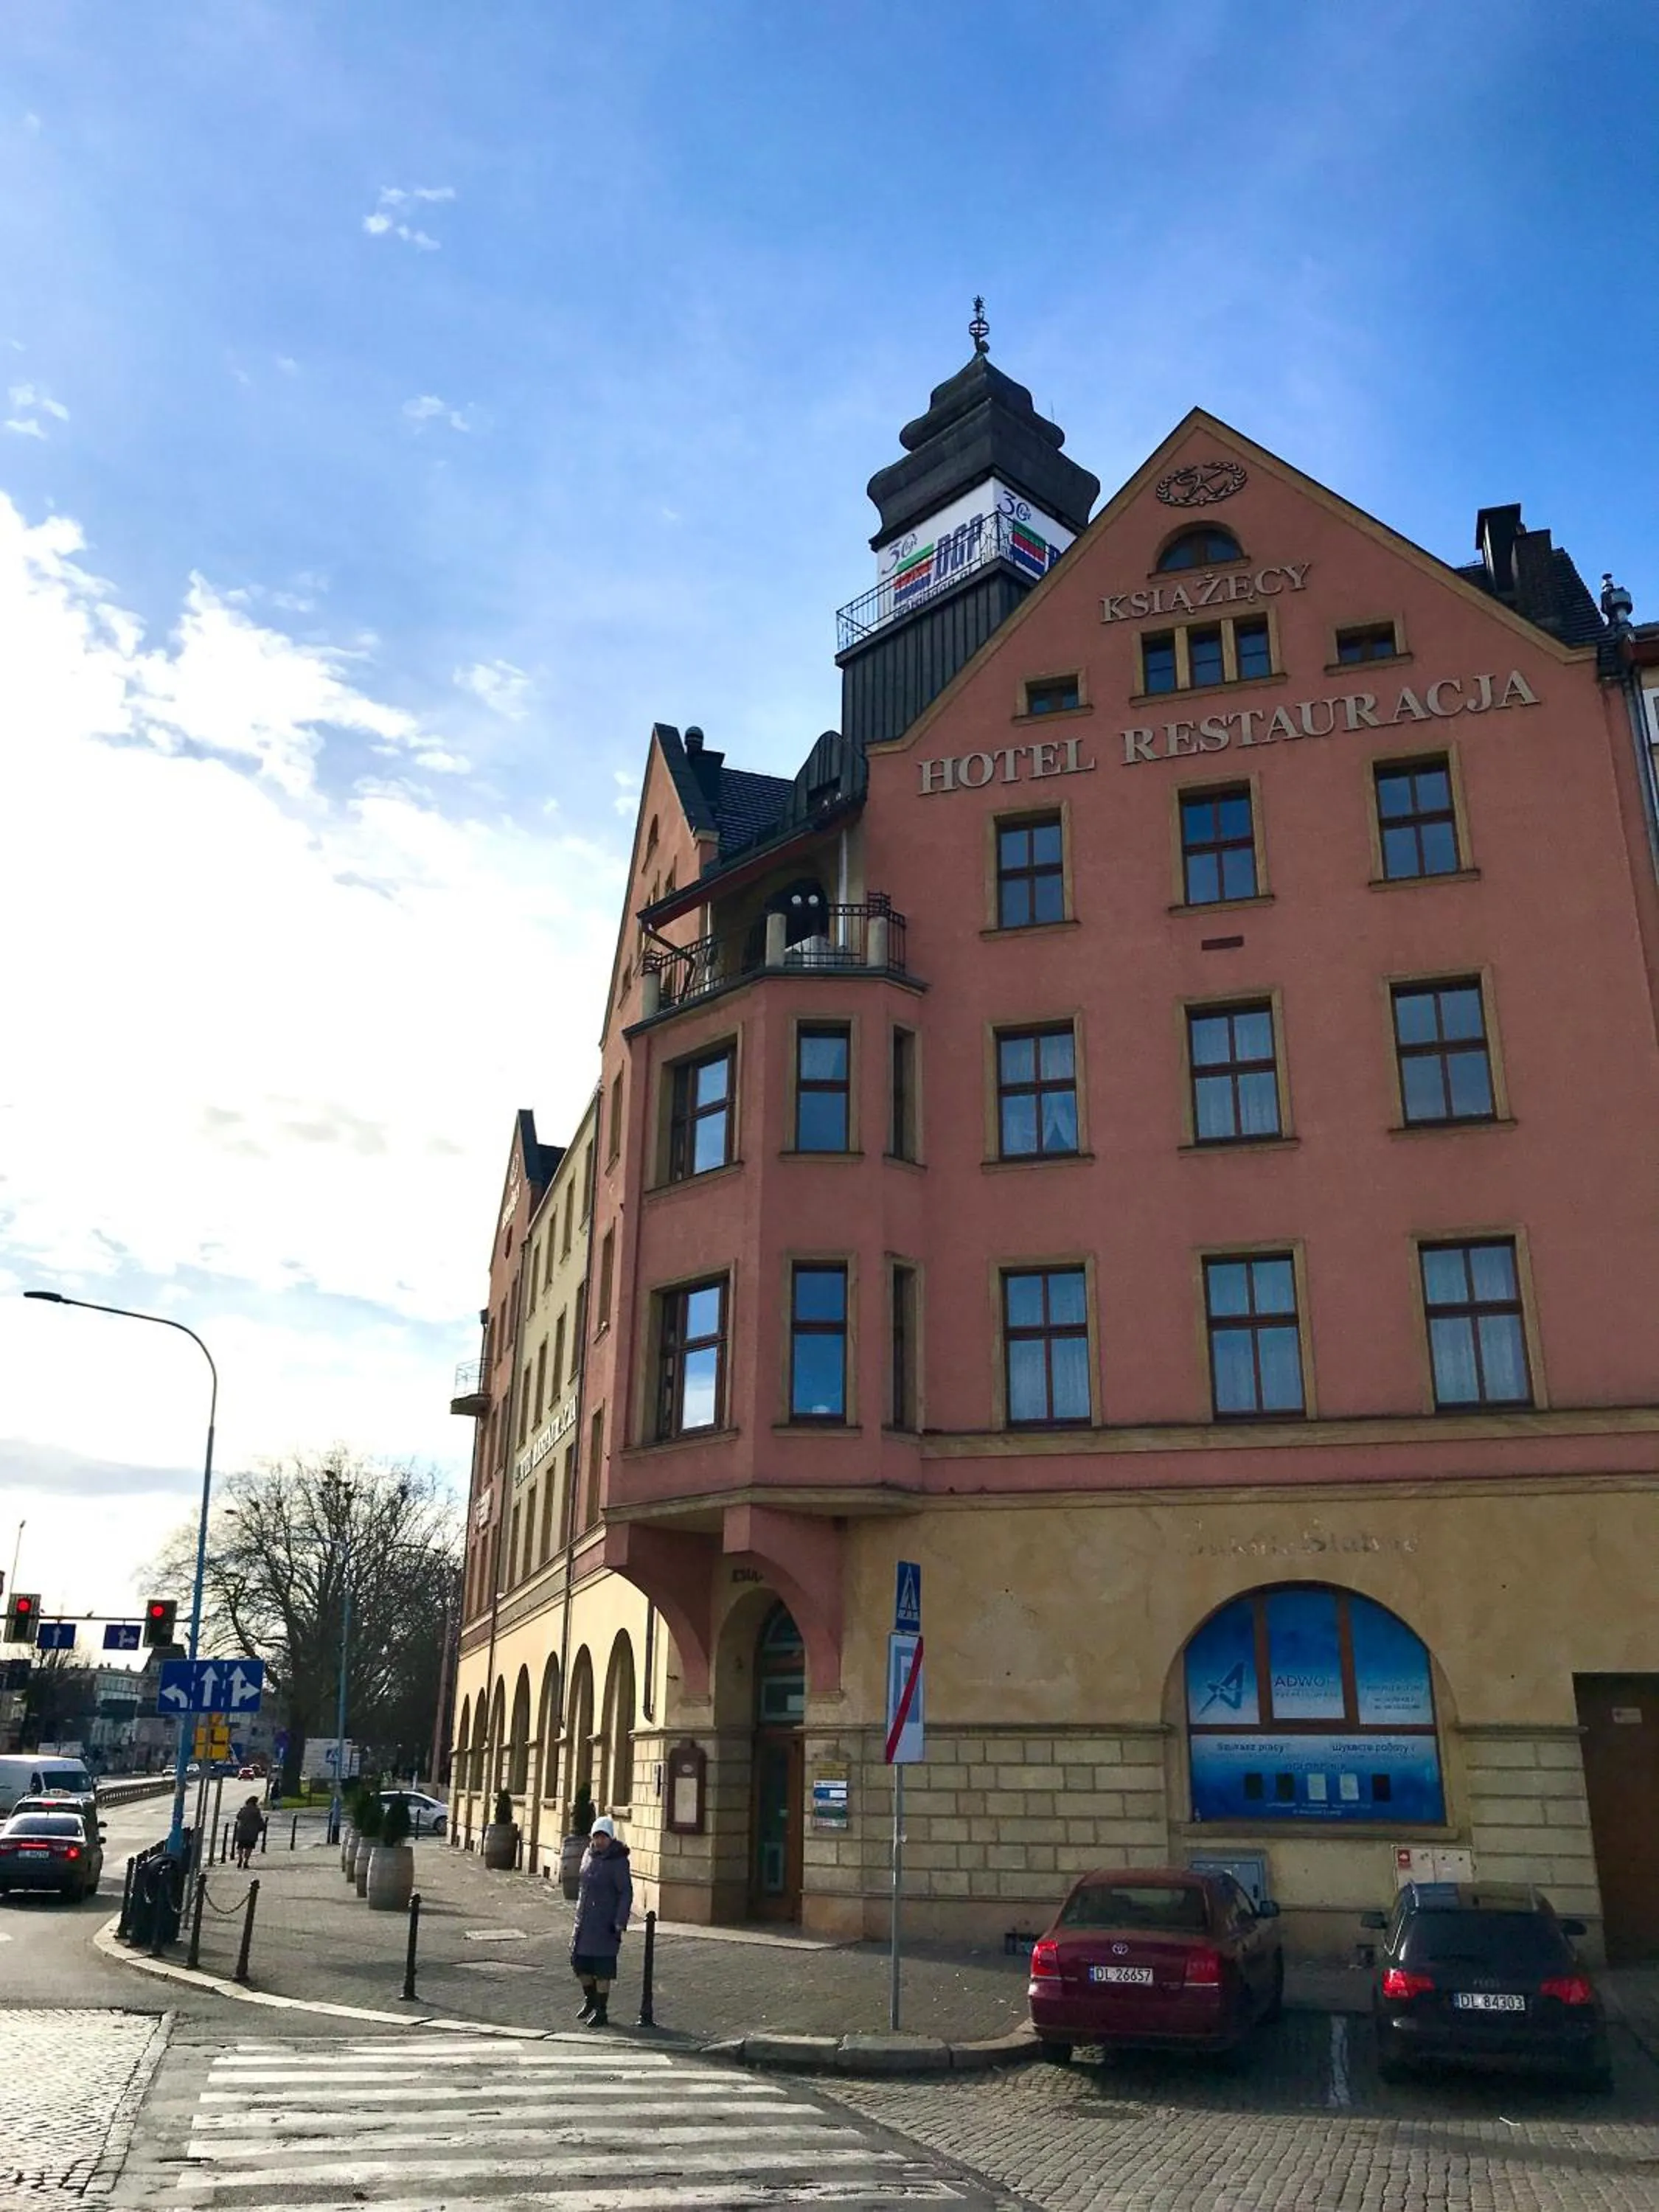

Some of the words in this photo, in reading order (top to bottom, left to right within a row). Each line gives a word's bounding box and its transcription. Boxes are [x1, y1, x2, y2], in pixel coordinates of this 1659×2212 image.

[1099, 562, 1311, 624] KSIĄŻECY
[917, 738, 1096, 797] HOTEL
[1120, 669, 1541, 765] RESTAURACJA
[1096, 1967, 1112, 1980] DL
[1116, 1968, 1151, 1982] 26657
[1461, 1994, 1479, 2008] DL
[1483, 1995, 1523, 2009] 84303
